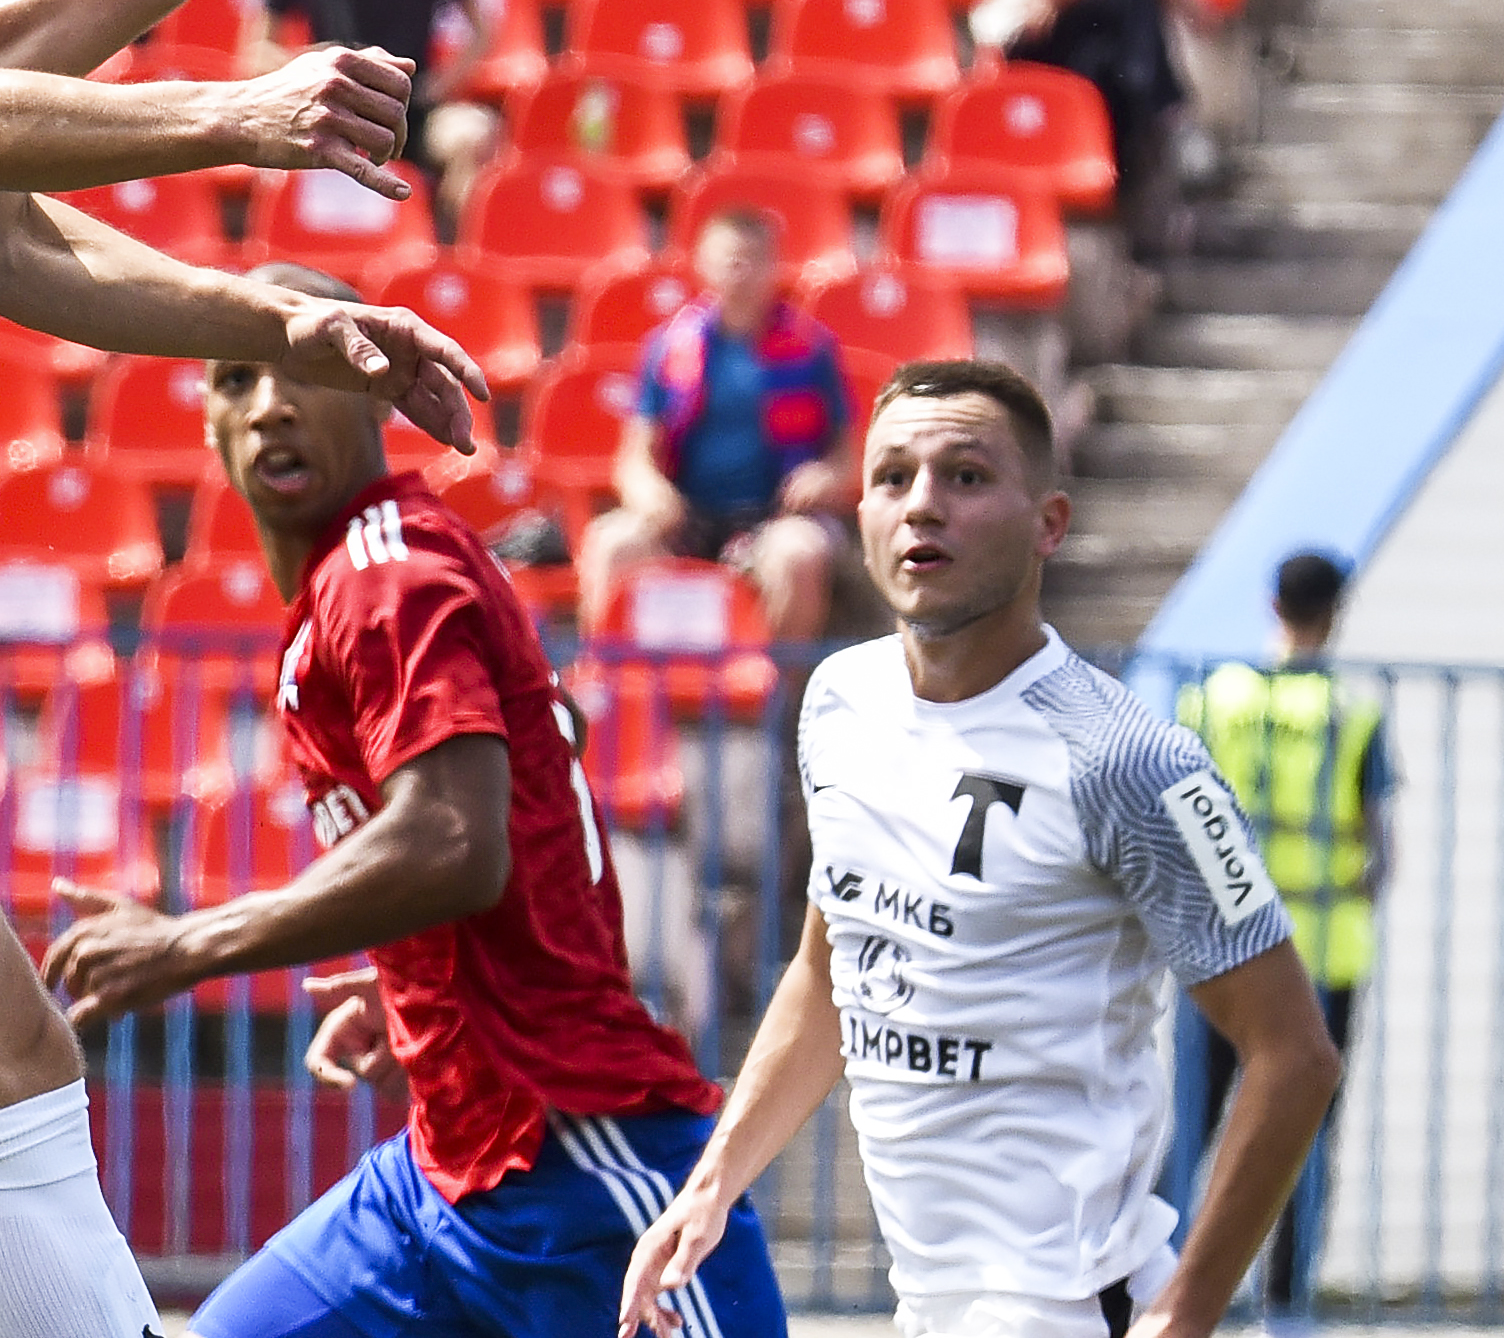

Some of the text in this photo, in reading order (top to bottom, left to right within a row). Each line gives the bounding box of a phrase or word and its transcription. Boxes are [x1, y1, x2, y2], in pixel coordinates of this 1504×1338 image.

[1180, 785, 1253, 907] Vorgol
[874, 882, 953, 939] МКБ
[849, 1015, 992, 1080] IMPBET
